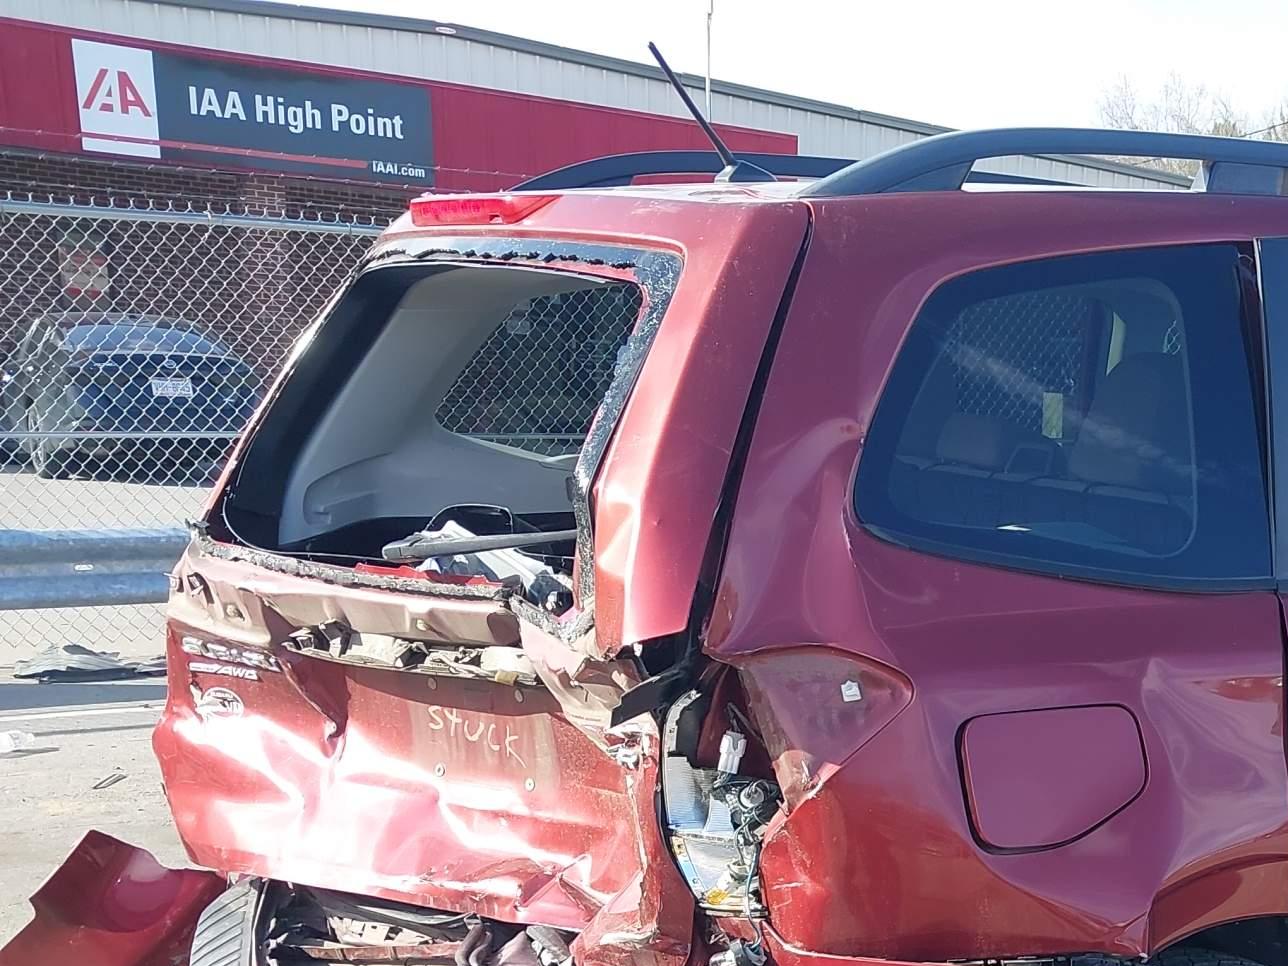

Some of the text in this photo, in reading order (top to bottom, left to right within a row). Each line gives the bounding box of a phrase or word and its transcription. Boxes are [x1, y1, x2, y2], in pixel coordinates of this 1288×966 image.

[188, 85, 404, 139] IAA High Point
[372, 160, 426, 178] IAAI.com
[428, 705, 527, 768] STUCK
